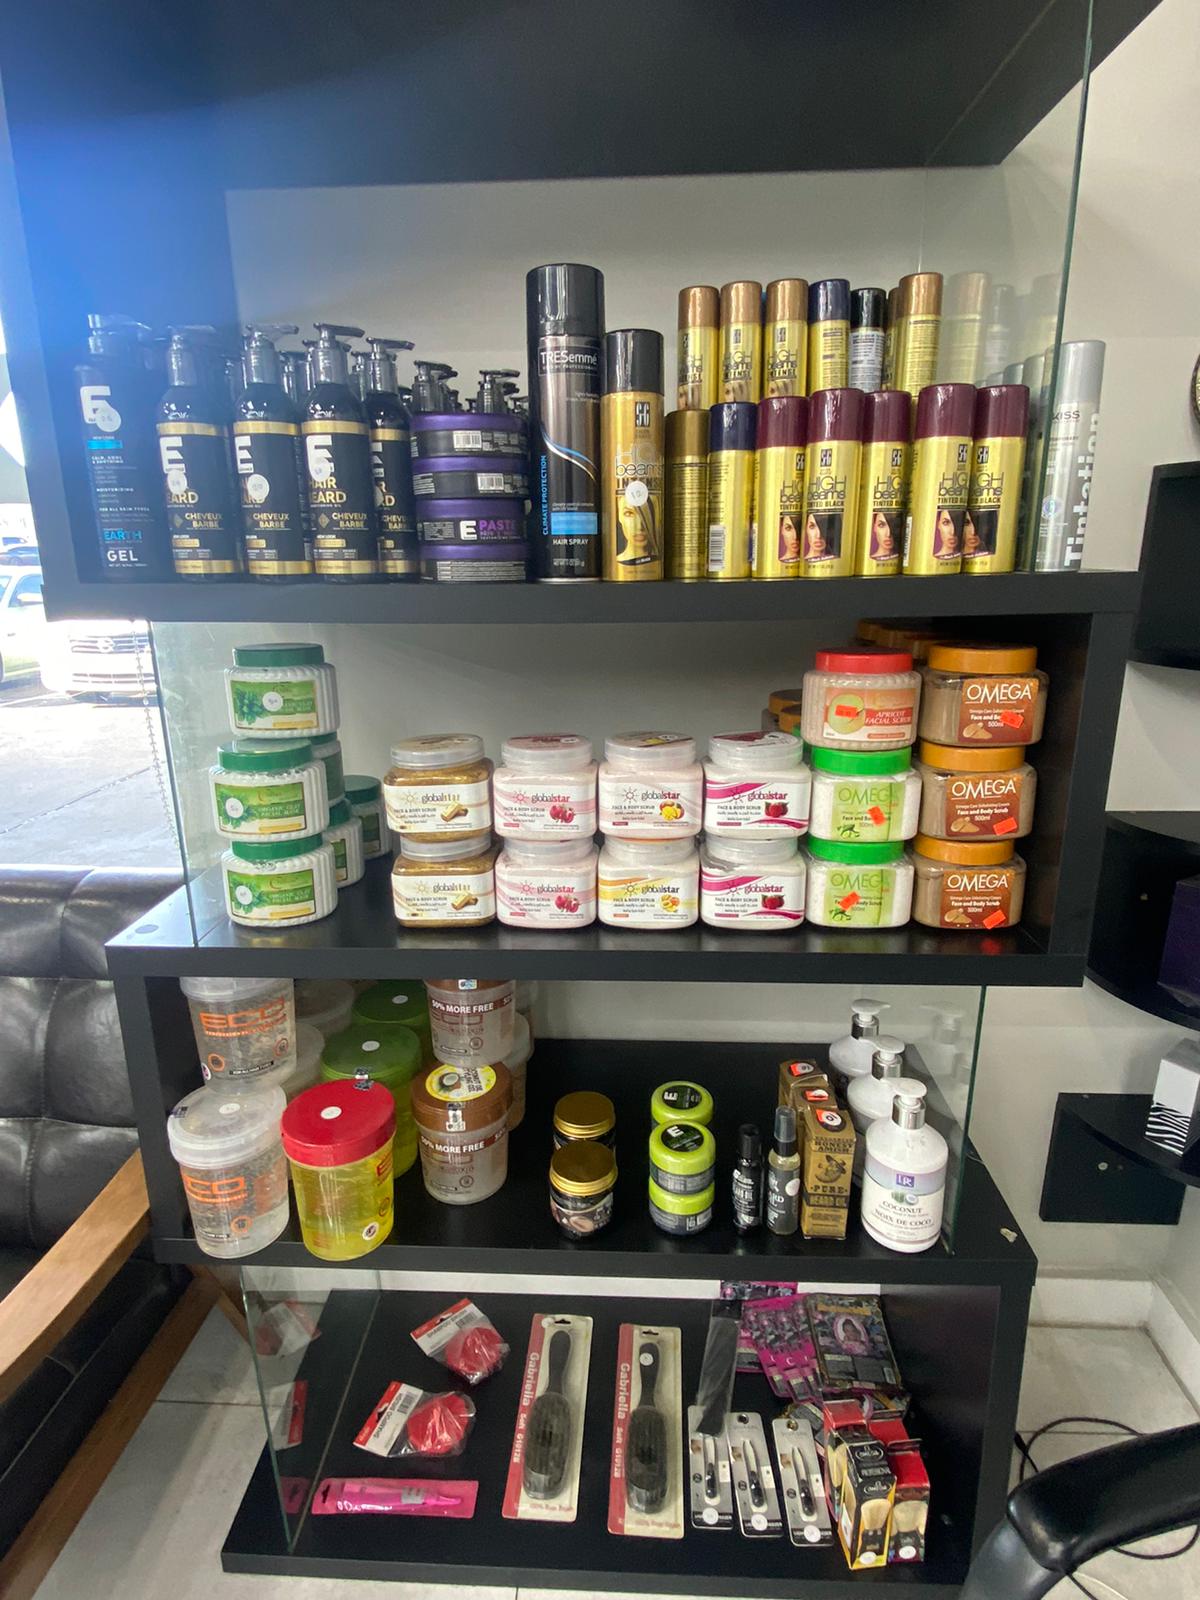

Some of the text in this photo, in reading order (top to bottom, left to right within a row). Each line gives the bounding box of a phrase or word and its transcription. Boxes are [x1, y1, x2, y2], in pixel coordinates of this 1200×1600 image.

[540, 455, 548, 503] PROTECTION
[252, 512, 290, 520] CHEVEUX
[107, 550, 138, 562] GEL
[967, 683, 1031, 704] OMEGA
[952, 779, 1016, 799] OMEGA
[531, 793, 570, 803] globalstar
[641, 790, 680, 801] globalstar
[947, 874, 1008, 891] OMEGA
[641, 884, 680, 894] globalstar
[446, 1005, 471, 1013] MORE
[473, 1003, 494, 1013] FREE
[435, 1142, 461, 1153] MORE
[463, 1141, 485, 1152] FREE
[814, 1185, 844, 1194] PURE
[882, 1200, 922, 1213] COCONUT
[522, 1352, 540, 1406] Gabriella
[618, 1363, 631, 1420] Gabriella
[518, 1413, 528, 1429] Soft
